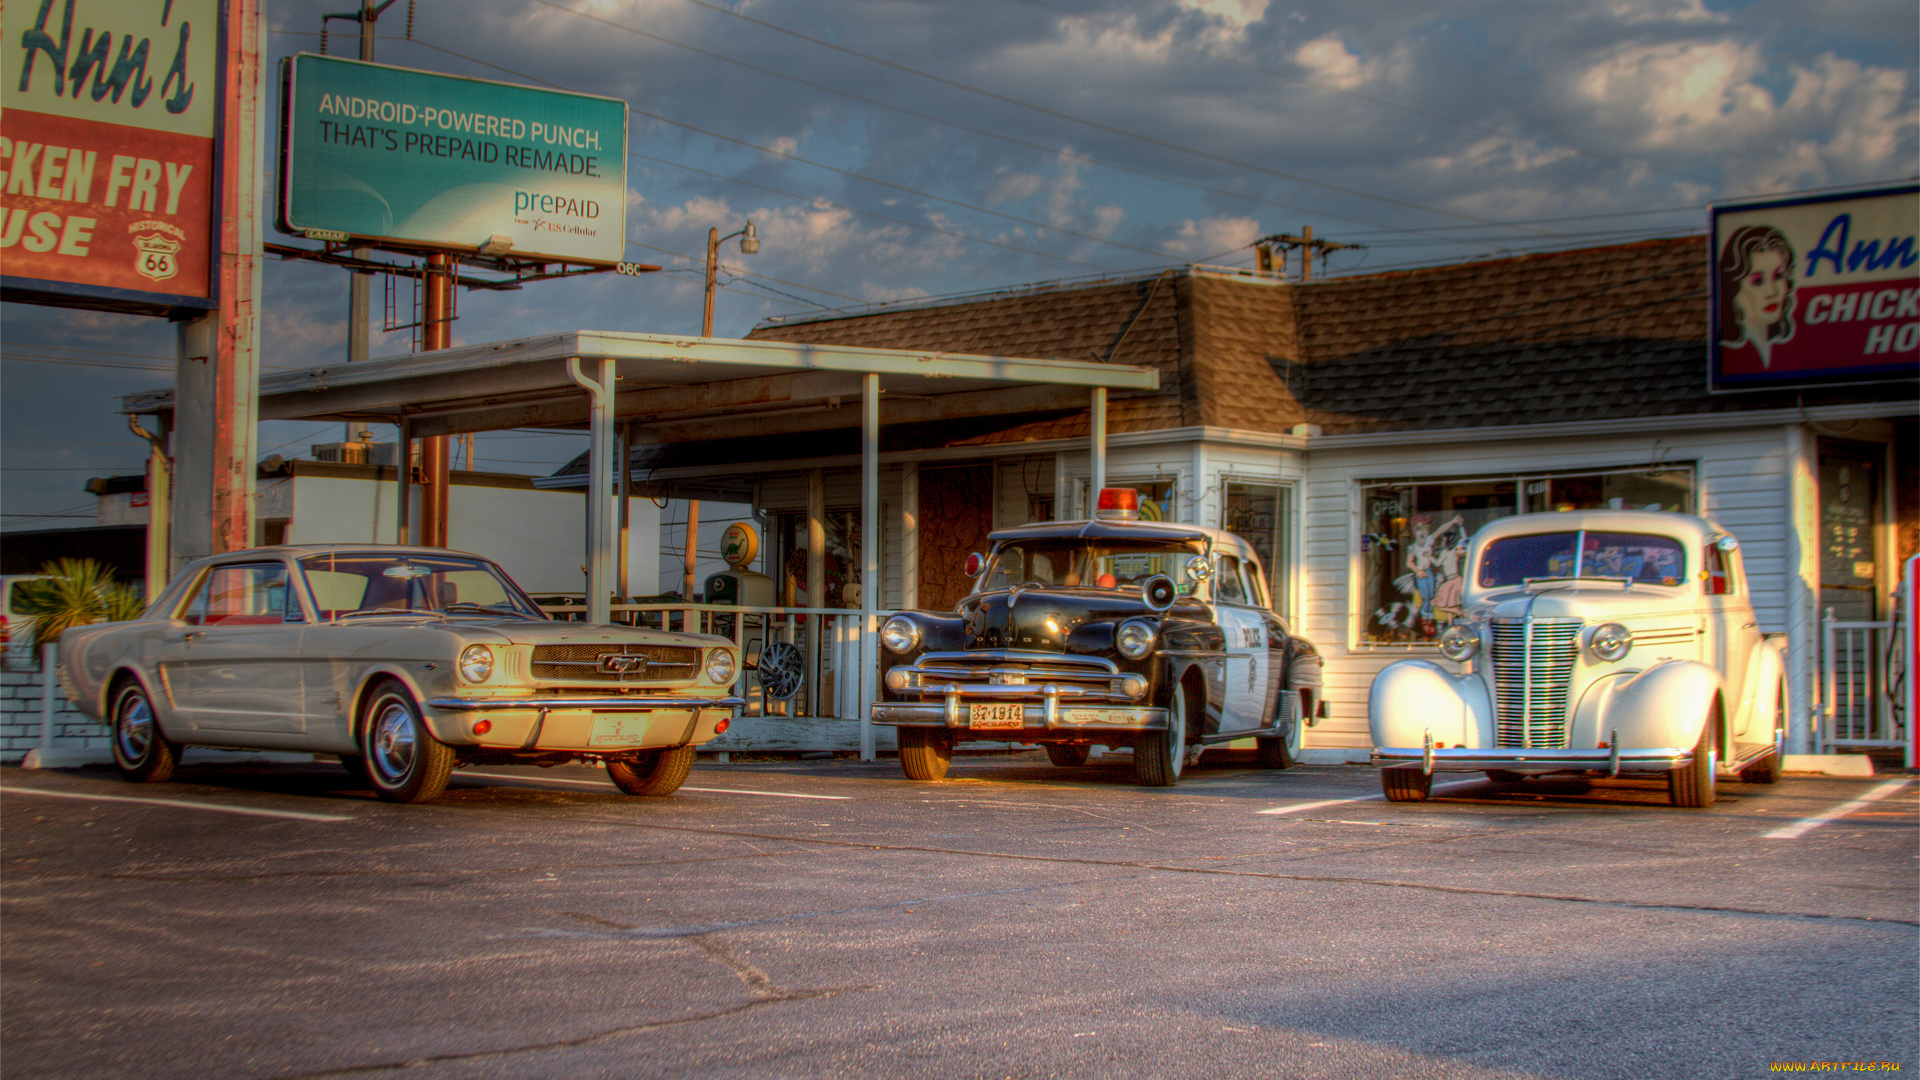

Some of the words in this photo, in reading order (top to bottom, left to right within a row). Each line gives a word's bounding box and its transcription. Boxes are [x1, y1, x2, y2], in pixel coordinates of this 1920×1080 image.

[18, 0, 194, 115] Ann's
[320, 120, 398, 151] THAT'S
[405, 131, 499, 163] PREPAID
[506, 144, 602, 178] REMADE.
[531, 121, 602, 151] PUNCH.
[104, 154, 194, 215] FRY
[515, 190, 599, 219] prePAID
[309, 230, 347, 240] LAMAR
[563, 223, 597, 237] Cellular
[145, 254, 168, 272] 66
[1804, 287, 1920, 325] CHICK
